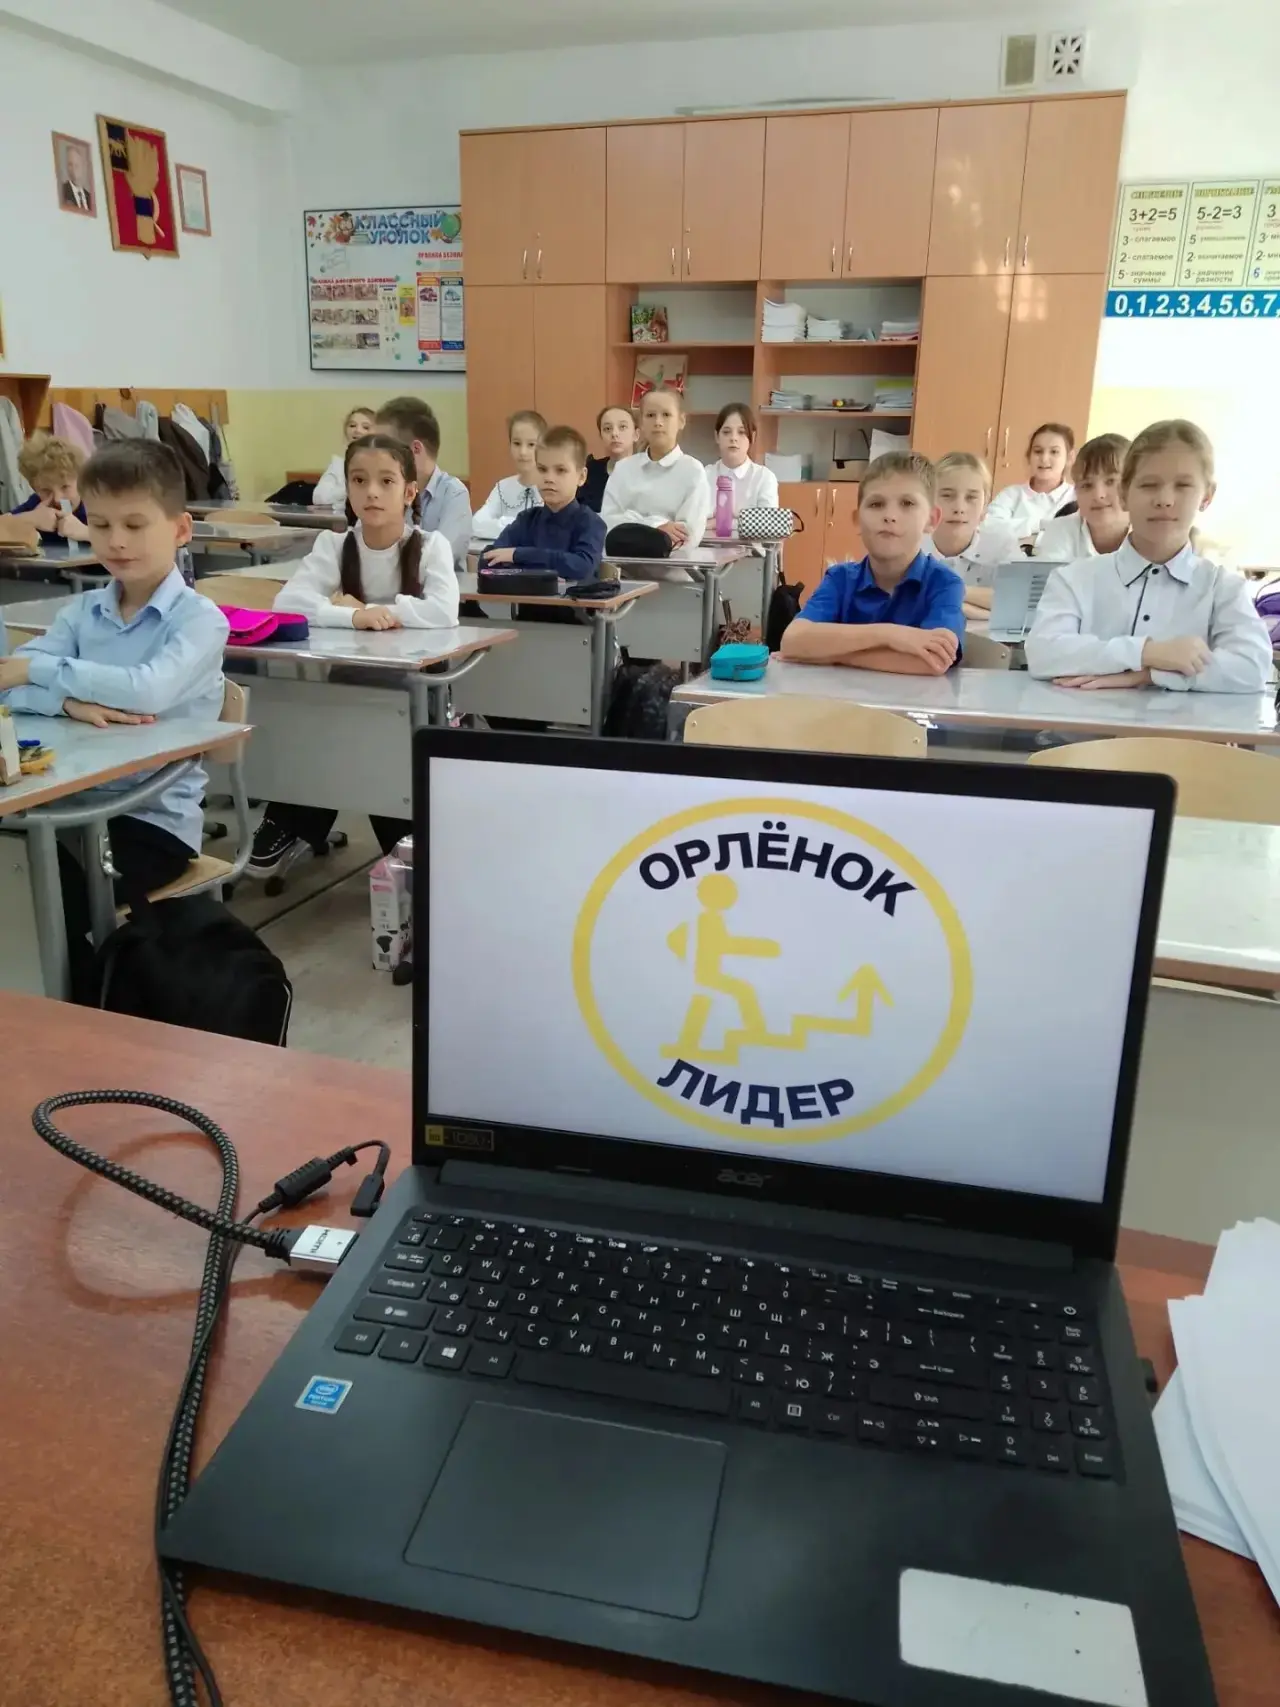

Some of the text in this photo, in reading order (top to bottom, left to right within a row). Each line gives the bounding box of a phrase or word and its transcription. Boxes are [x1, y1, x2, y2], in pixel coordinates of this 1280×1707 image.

[1129, 207, 1178, 222] 3+2=5
[1196, 205, 1242, 220] 5-2=3
[355, 212, 441, 229] КЛАССНЫЙ
[369, 230, 431, 244] УГОЛОК
[1122, 236, 1129, 246] 3
[1189, 234, 1196, 244] 5
[1258, 232, 1266, 244] 3
[1120, 252, 1127, 262] 2
[1187, 252, 1194, 262] 2
[1256, 250, 1264, 261] 2
[1118, 270, 1125, 280] 5
[1184, 269, 1191, 279] 3
[640, 821, 915, 916] ОРЛЁНОК
[657, 1059, 853, 1128] ЛИДЕР
[443, 1254, 451, 1263] Q
[482, 1260, 492, 1268] W
[452, 1265, 463, 1274] Й
[491, 1271, 500, 1280] Ц
[439, 1281, 447, 1289] A
[530, 1278, 539, 1286] У
[598, 1277, 605, 1285] T
[478, 1287, 484, 1295] S
[570, 1284, 579, 1292] К
[637, 1284, 644, 1292] Y
[449, 1293, 459, 1301] Ф
[517, 1293, 526, 1301] D
[610, 1290, 619, 1298] Е
[677, 1290, 685, 1298] U
[782, 1290, 789, 1298] 0
[487, 1299, 499, 1307] Ы
[557, 1298, 564, 1307] F
[650, 1297, 659, 1305] Н
[530, 1306, 539, 1314] В
[598, 1306, 607, 1314] G
[692, 1302, 699, 1310] Г
[446, 1310, 454, 1318] Z
[571, 1313, 580, 1321] А
[639, 1312, 647, 1320] H
[730, 1309, 741, 1318] Ш
[800, 1309, 807, 1317] P
[486, 1317, 495, 1325] X
[611, 1318, 621, 1327] П
[771, 1313, 782, 1323] Щ
[456, 1324, 467, 1332] Я
[527, 1323, 535, 1332] C
[653, 1325, 662, 1333] Р
[722, 1325, 729, 1334] K
[817, 1322, 825, 1331] З
[499, 1330, 508, 1339] Ч
[569, 1330, 577, 1338] V
[860, 1329, 868, 1338] Х
[539, 1337, 549, 1346] С
[610, 1337, 617, 1345] B
[738, 1338, 747, 1348] Л
[902, 1335, 912, 1344] Ъ
[579, 1344, 591, 1353] М
[652, 1343, 661, 1353] N
[779, 1344, 790, 1354] Д
[624, 1351, 634, 1360] И
[696, 1350, 706, 1360] M
[821, 1352, 834, 1361] Ж
[669, 1358, 676, 1366] Т
[869, 1359, 879, 1368] Э
[711, 1365, 720, 1374] Ь
[756, 1372, 764, 1381] Б
[796, 1379, 809, 1389] Ю
[1080, 1386, 1087, 1394] 6
[1085, 1418, 1091, 1426] 3
[1007, 1436, 1014, 1445] 0
